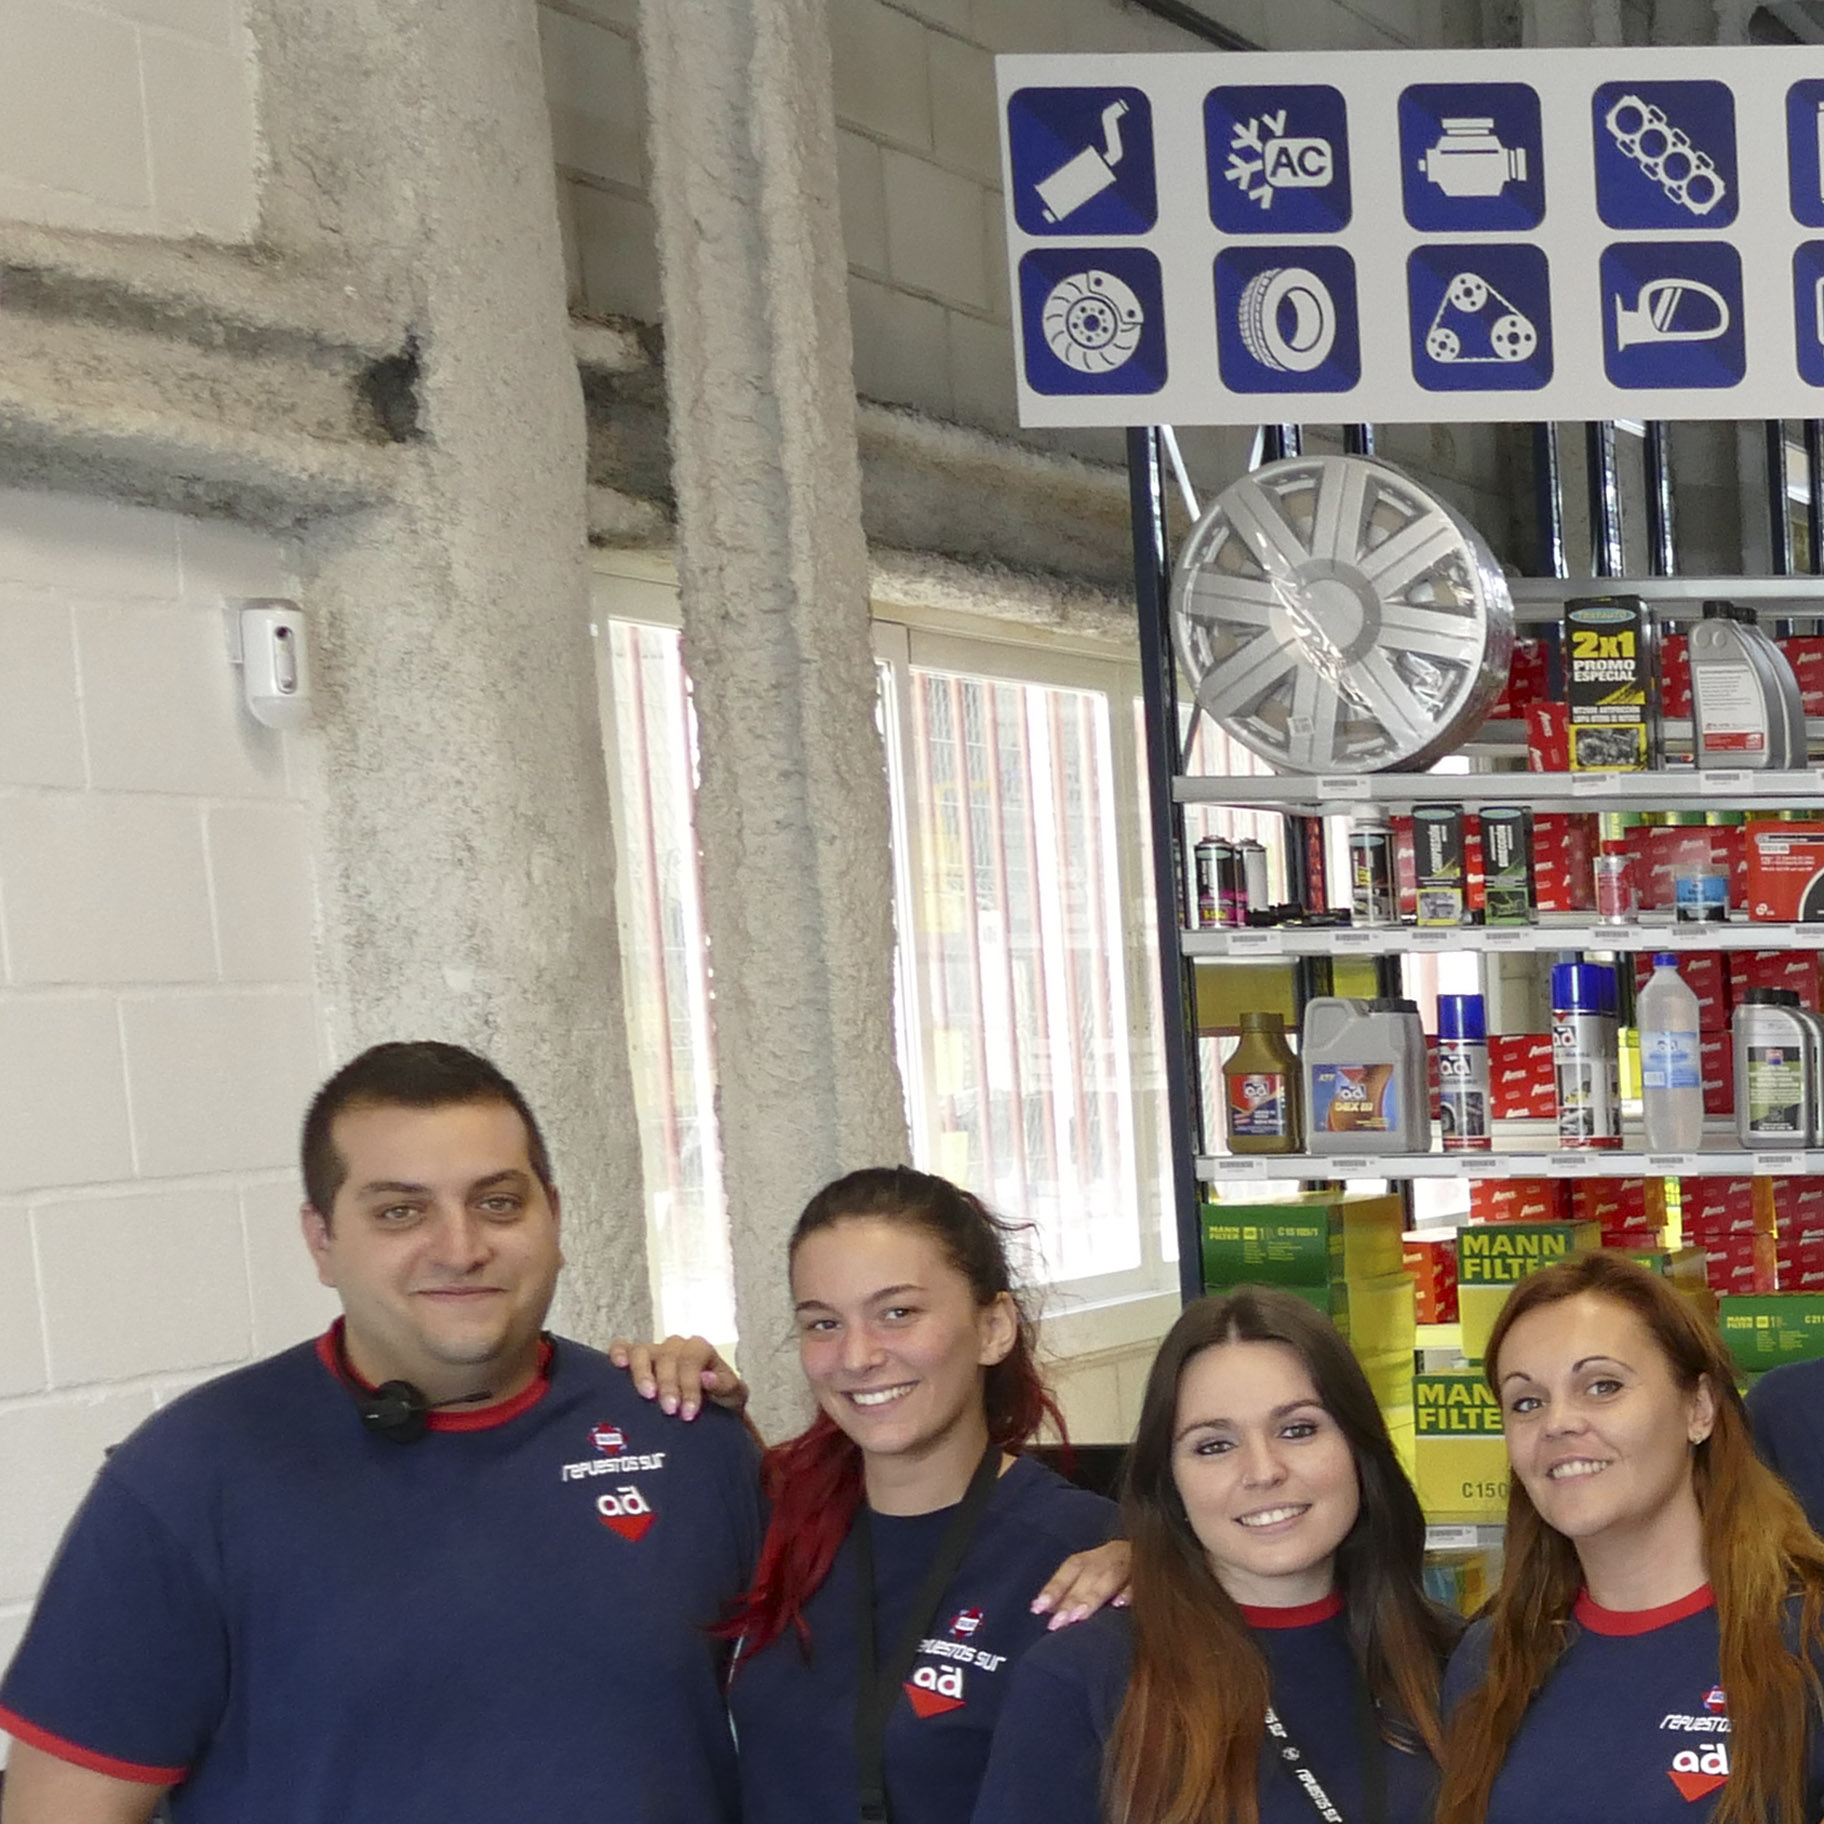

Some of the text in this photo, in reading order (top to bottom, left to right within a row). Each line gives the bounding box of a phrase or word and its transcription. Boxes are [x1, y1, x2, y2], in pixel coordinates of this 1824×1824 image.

[1271, 147, 1327, 179] AC
[1572, 631, 1635, 658] 2x1
[1573, 660, 1635, 670] PROMO
[1574, 671, 1636, 682] ESPECIAL
[1441, 1055, 1472, 1076] ad
[1335, 1102, 1360, 1111] DEX
[1463, 1234, 1565, 1256] MANN
[1417, 1384, 1498, 1405] MAN
[1420, 1408, 1503, 1430] FILTE
[597, 1486, 651, 1516] ad
[913, 1664, 962, 1699] ad
[1672, 1743, 1729, 1775] ad
